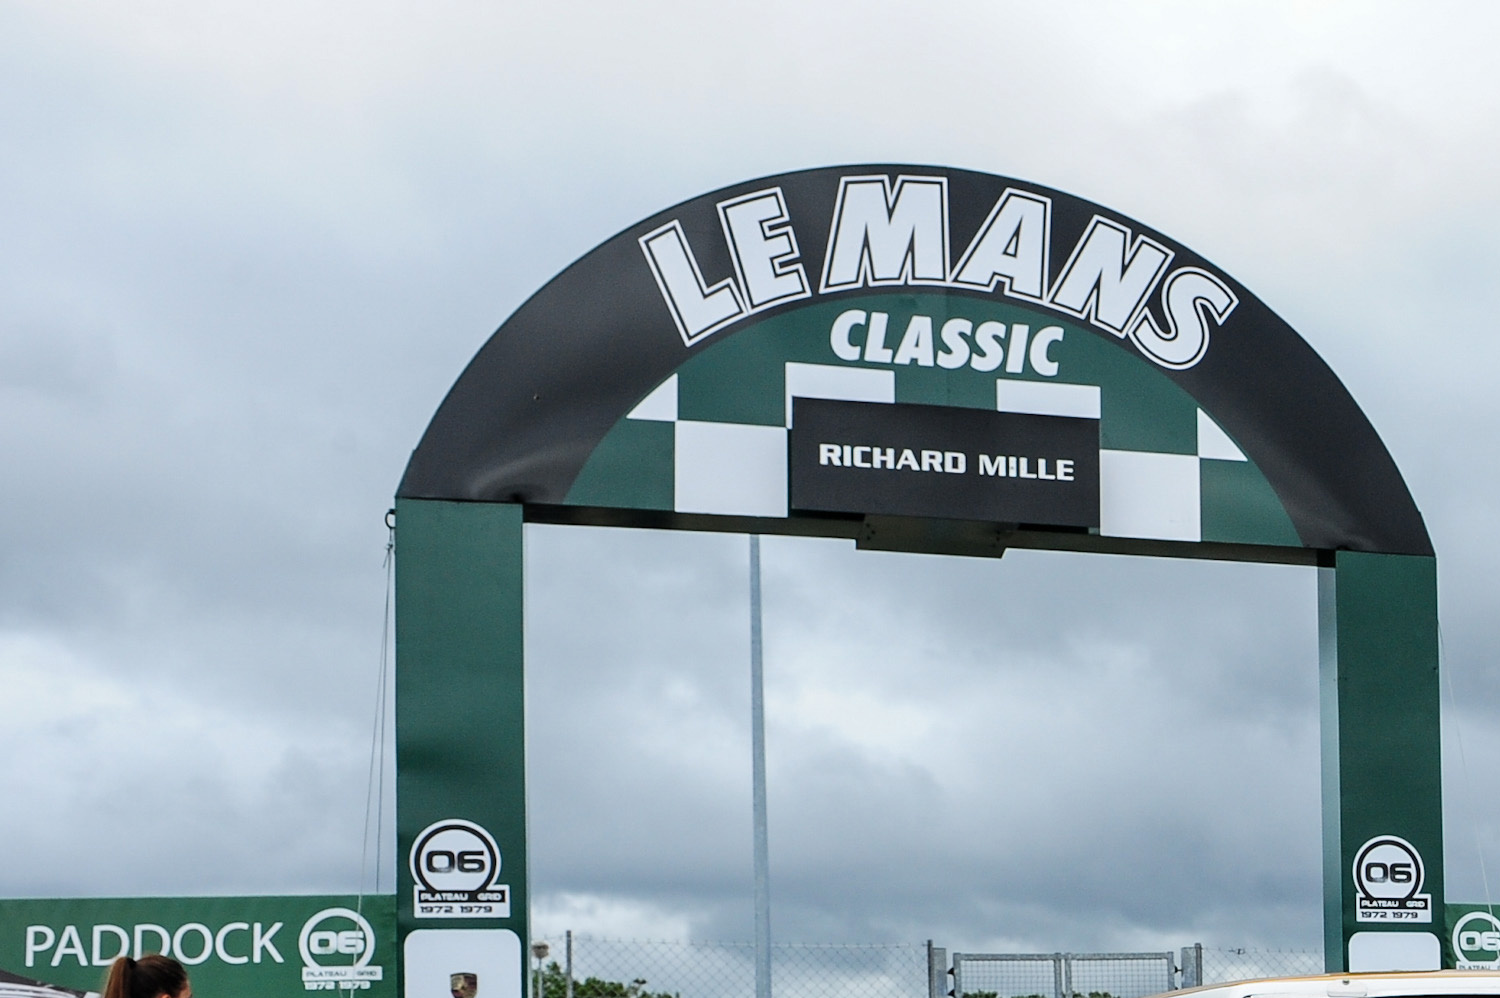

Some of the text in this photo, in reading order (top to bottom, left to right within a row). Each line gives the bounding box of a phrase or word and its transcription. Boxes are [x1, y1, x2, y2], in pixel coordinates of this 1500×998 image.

[637, 174, 1239, 370] LE MANS
[830, 307, 1064, 377] CLASSIC
[819, 442, 1075, 482] RICHARD MILLE
[426, 850, 485, 873] 06
[1366, 862, 1412, 883] 06
[421, 893, 469, 901] PLATEAU
[420, 905, 493, 913] 1972 1979
[1361, 911, 1418, 919] 1972 1979
[25, 922, 285, 967] PADDOCK
[309, 931, 365, 954] 06
